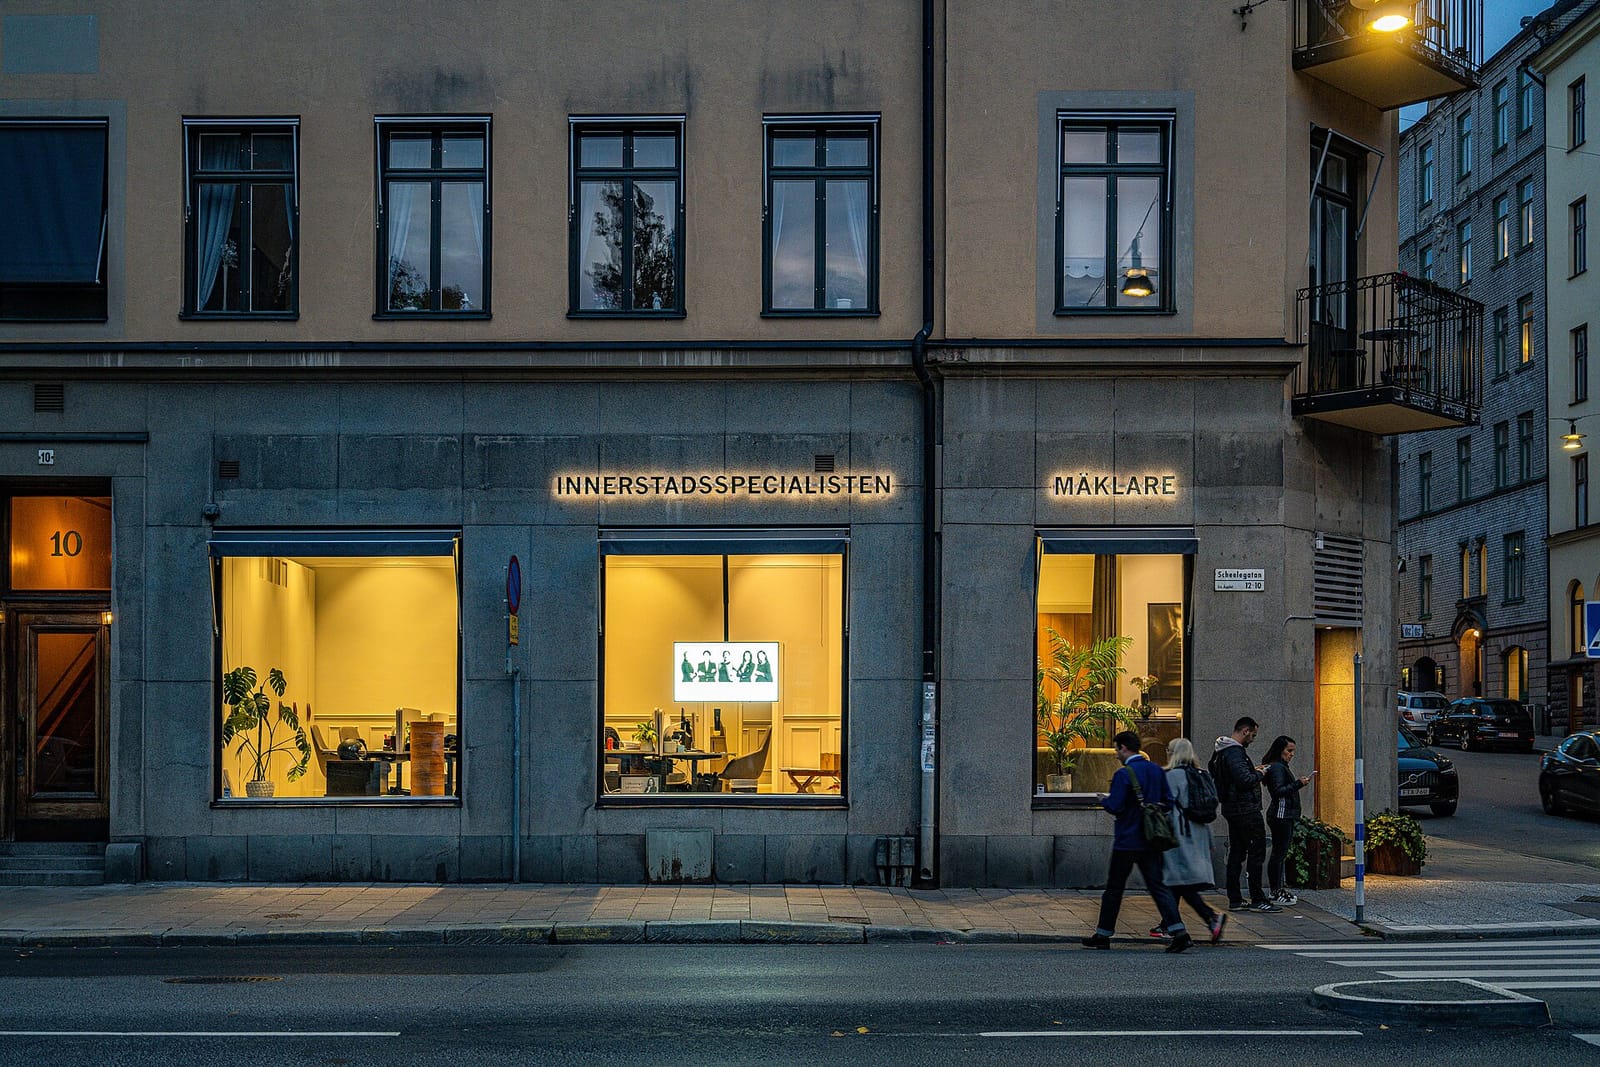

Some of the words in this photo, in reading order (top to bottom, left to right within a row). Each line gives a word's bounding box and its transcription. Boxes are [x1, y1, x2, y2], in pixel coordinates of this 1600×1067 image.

[40, 452, 51, 463] 10
[557, 475, 891, 495] INNERSTADSSPECIALISTEN
[1055, 472, 1176, 496] MÄKLARE
[49, 530, 83, 557] 10
[1217, 570, 1262, 580] Scheelegatan
